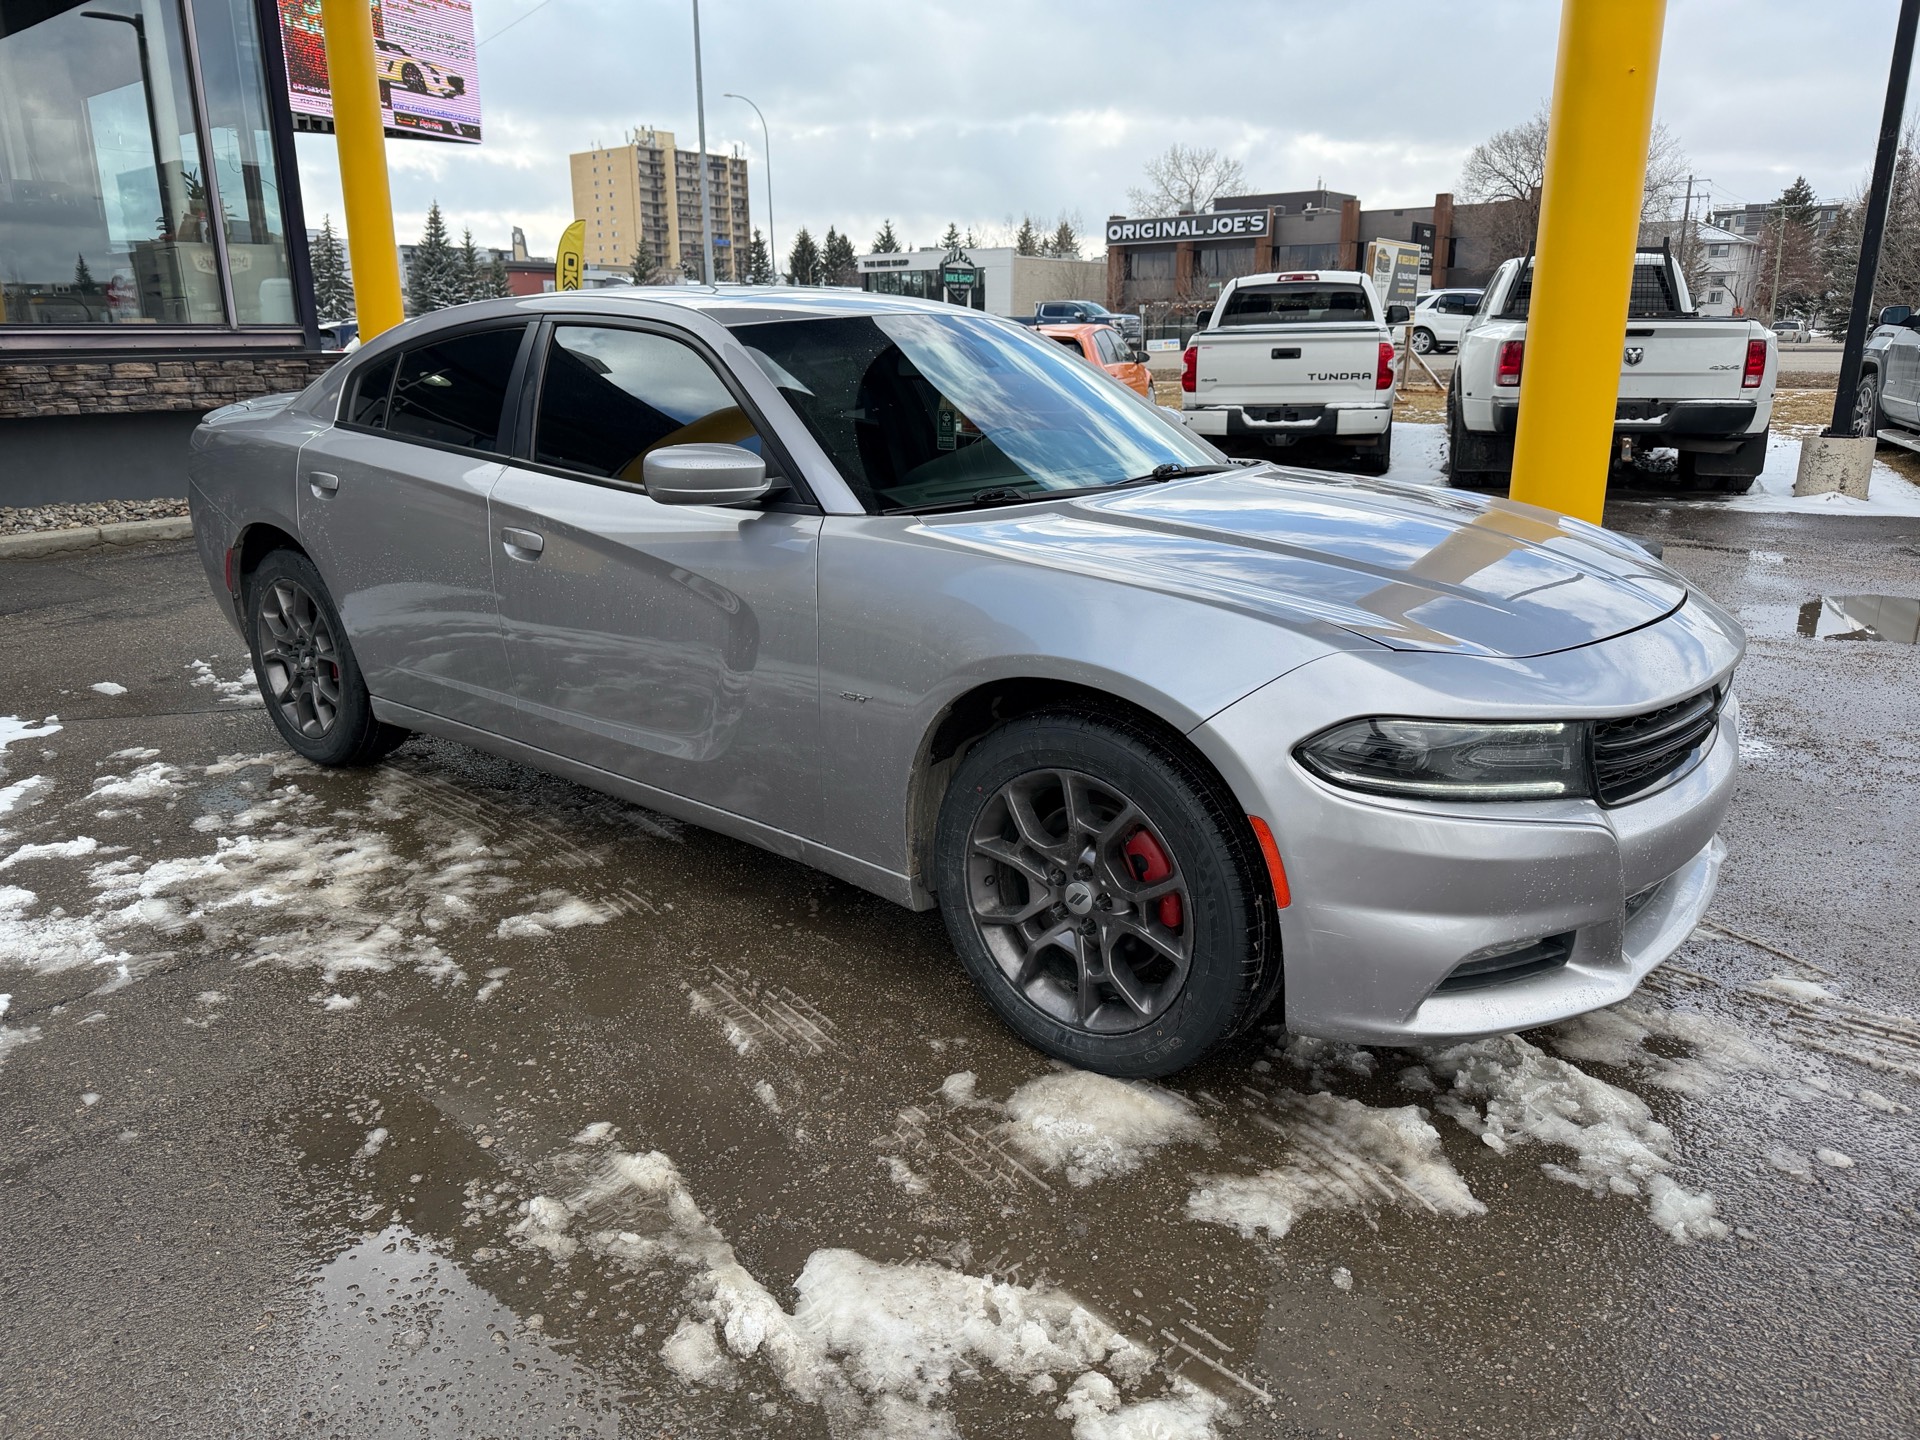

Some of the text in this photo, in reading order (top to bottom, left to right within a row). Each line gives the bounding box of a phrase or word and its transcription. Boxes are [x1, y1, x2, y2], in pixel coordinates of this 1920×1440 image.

[1108, 215, 1264, 240] ORIGINAL JOE'S
[945, 273, 975, 283] BIKE SHOP
[1307, 372, 1372, 381] TUNDRA
